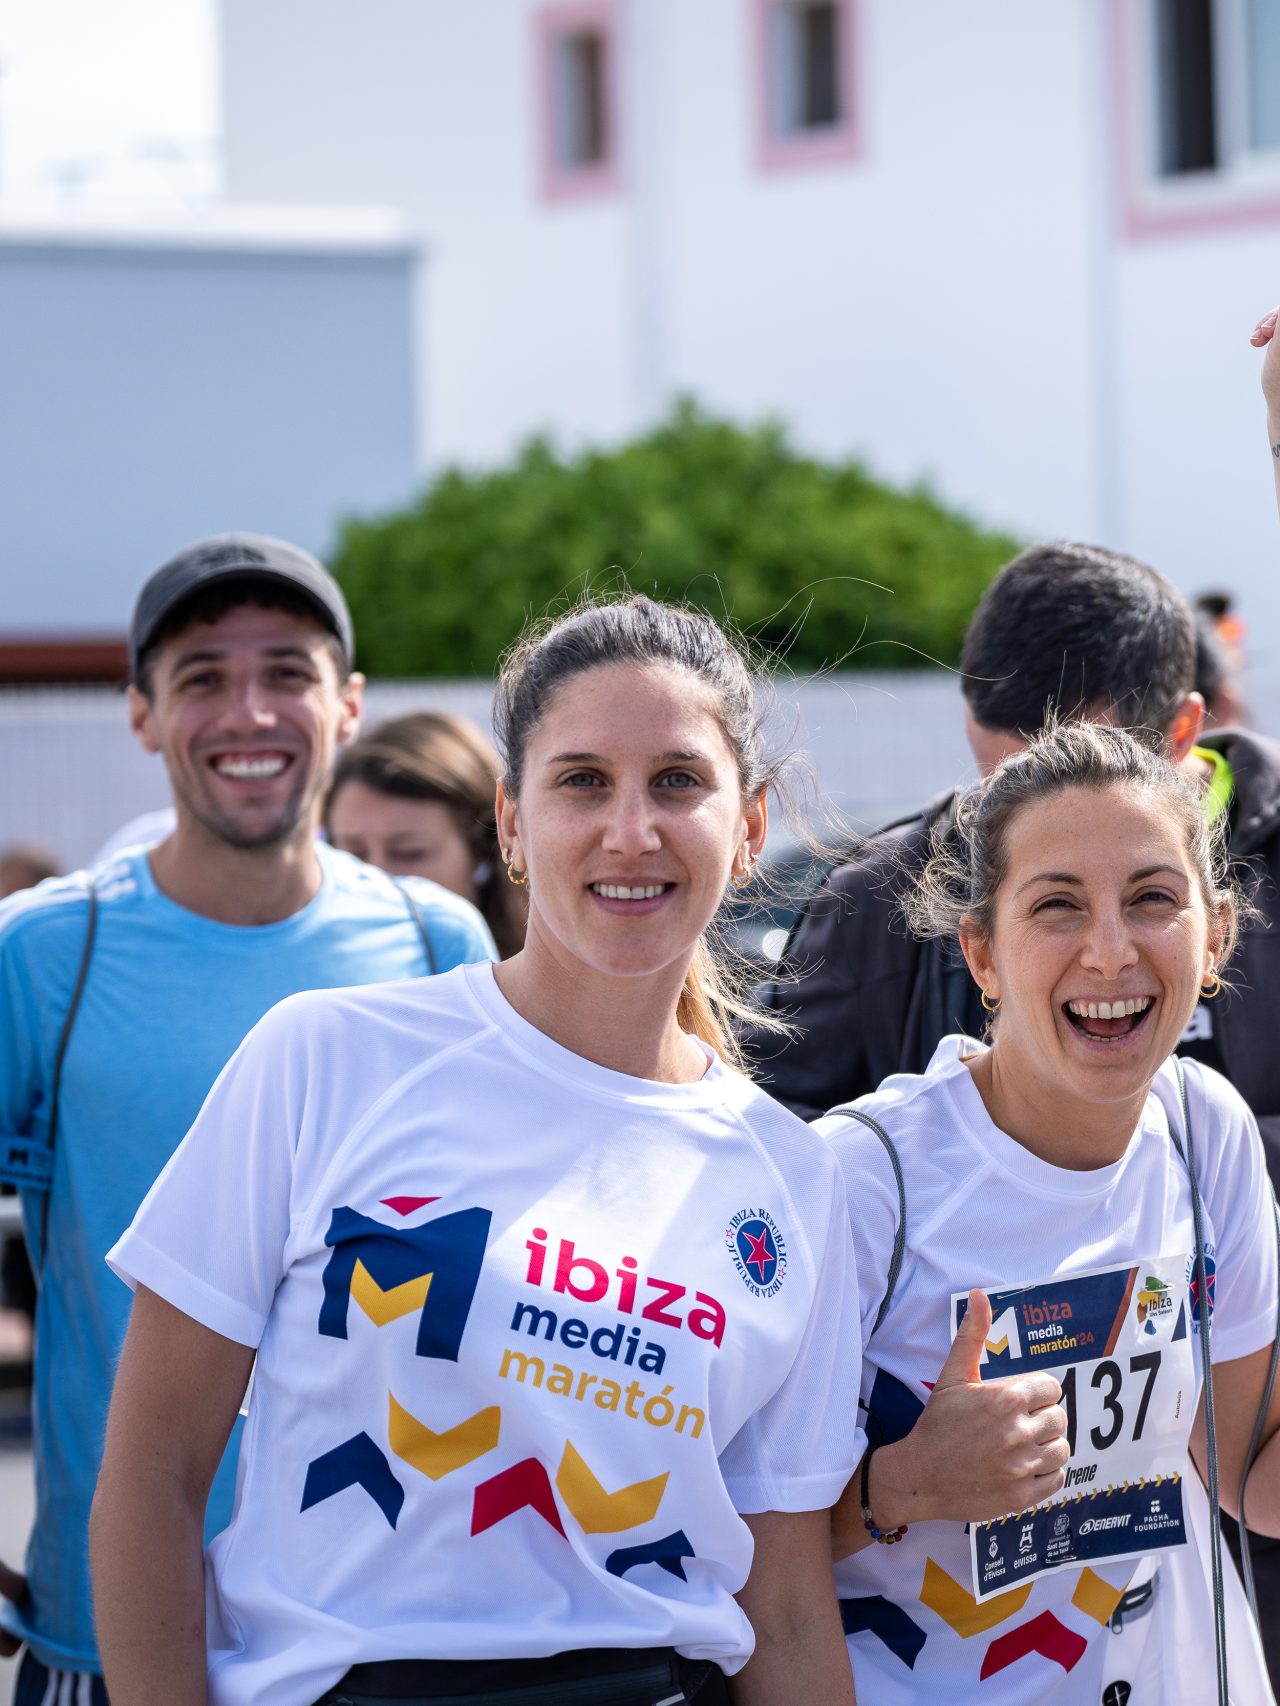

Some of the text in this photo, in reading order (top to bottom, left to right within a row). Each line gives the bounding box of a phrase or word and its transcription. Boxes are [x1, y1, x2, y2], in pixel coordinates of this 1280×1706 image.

[728, 1208, 788, 1268] IBIZA REPUBLIC
[524, 1227, 727, 1350] ibiza
[761, 1278, 783, 1298] IBIZA
[1022, 1300, 1073, 1326] ibiza
[1149, 1297, 1172, 1312] Ibiza
[510, 1301, 668, 1376] media
[1027, 1324, 1064, 1341] media
[498, 1348, 706, 1440] maratón
[1063, 1463, 1098, 1488] Irene
[1093, 1514, 1132, 1532] ENERVIT
[1134, 1519, 1180, 1533] FOUNDATION
[1143, 1513, 1169, 1524] PACHA
[984, 1556, 1004, 1571] Consell
